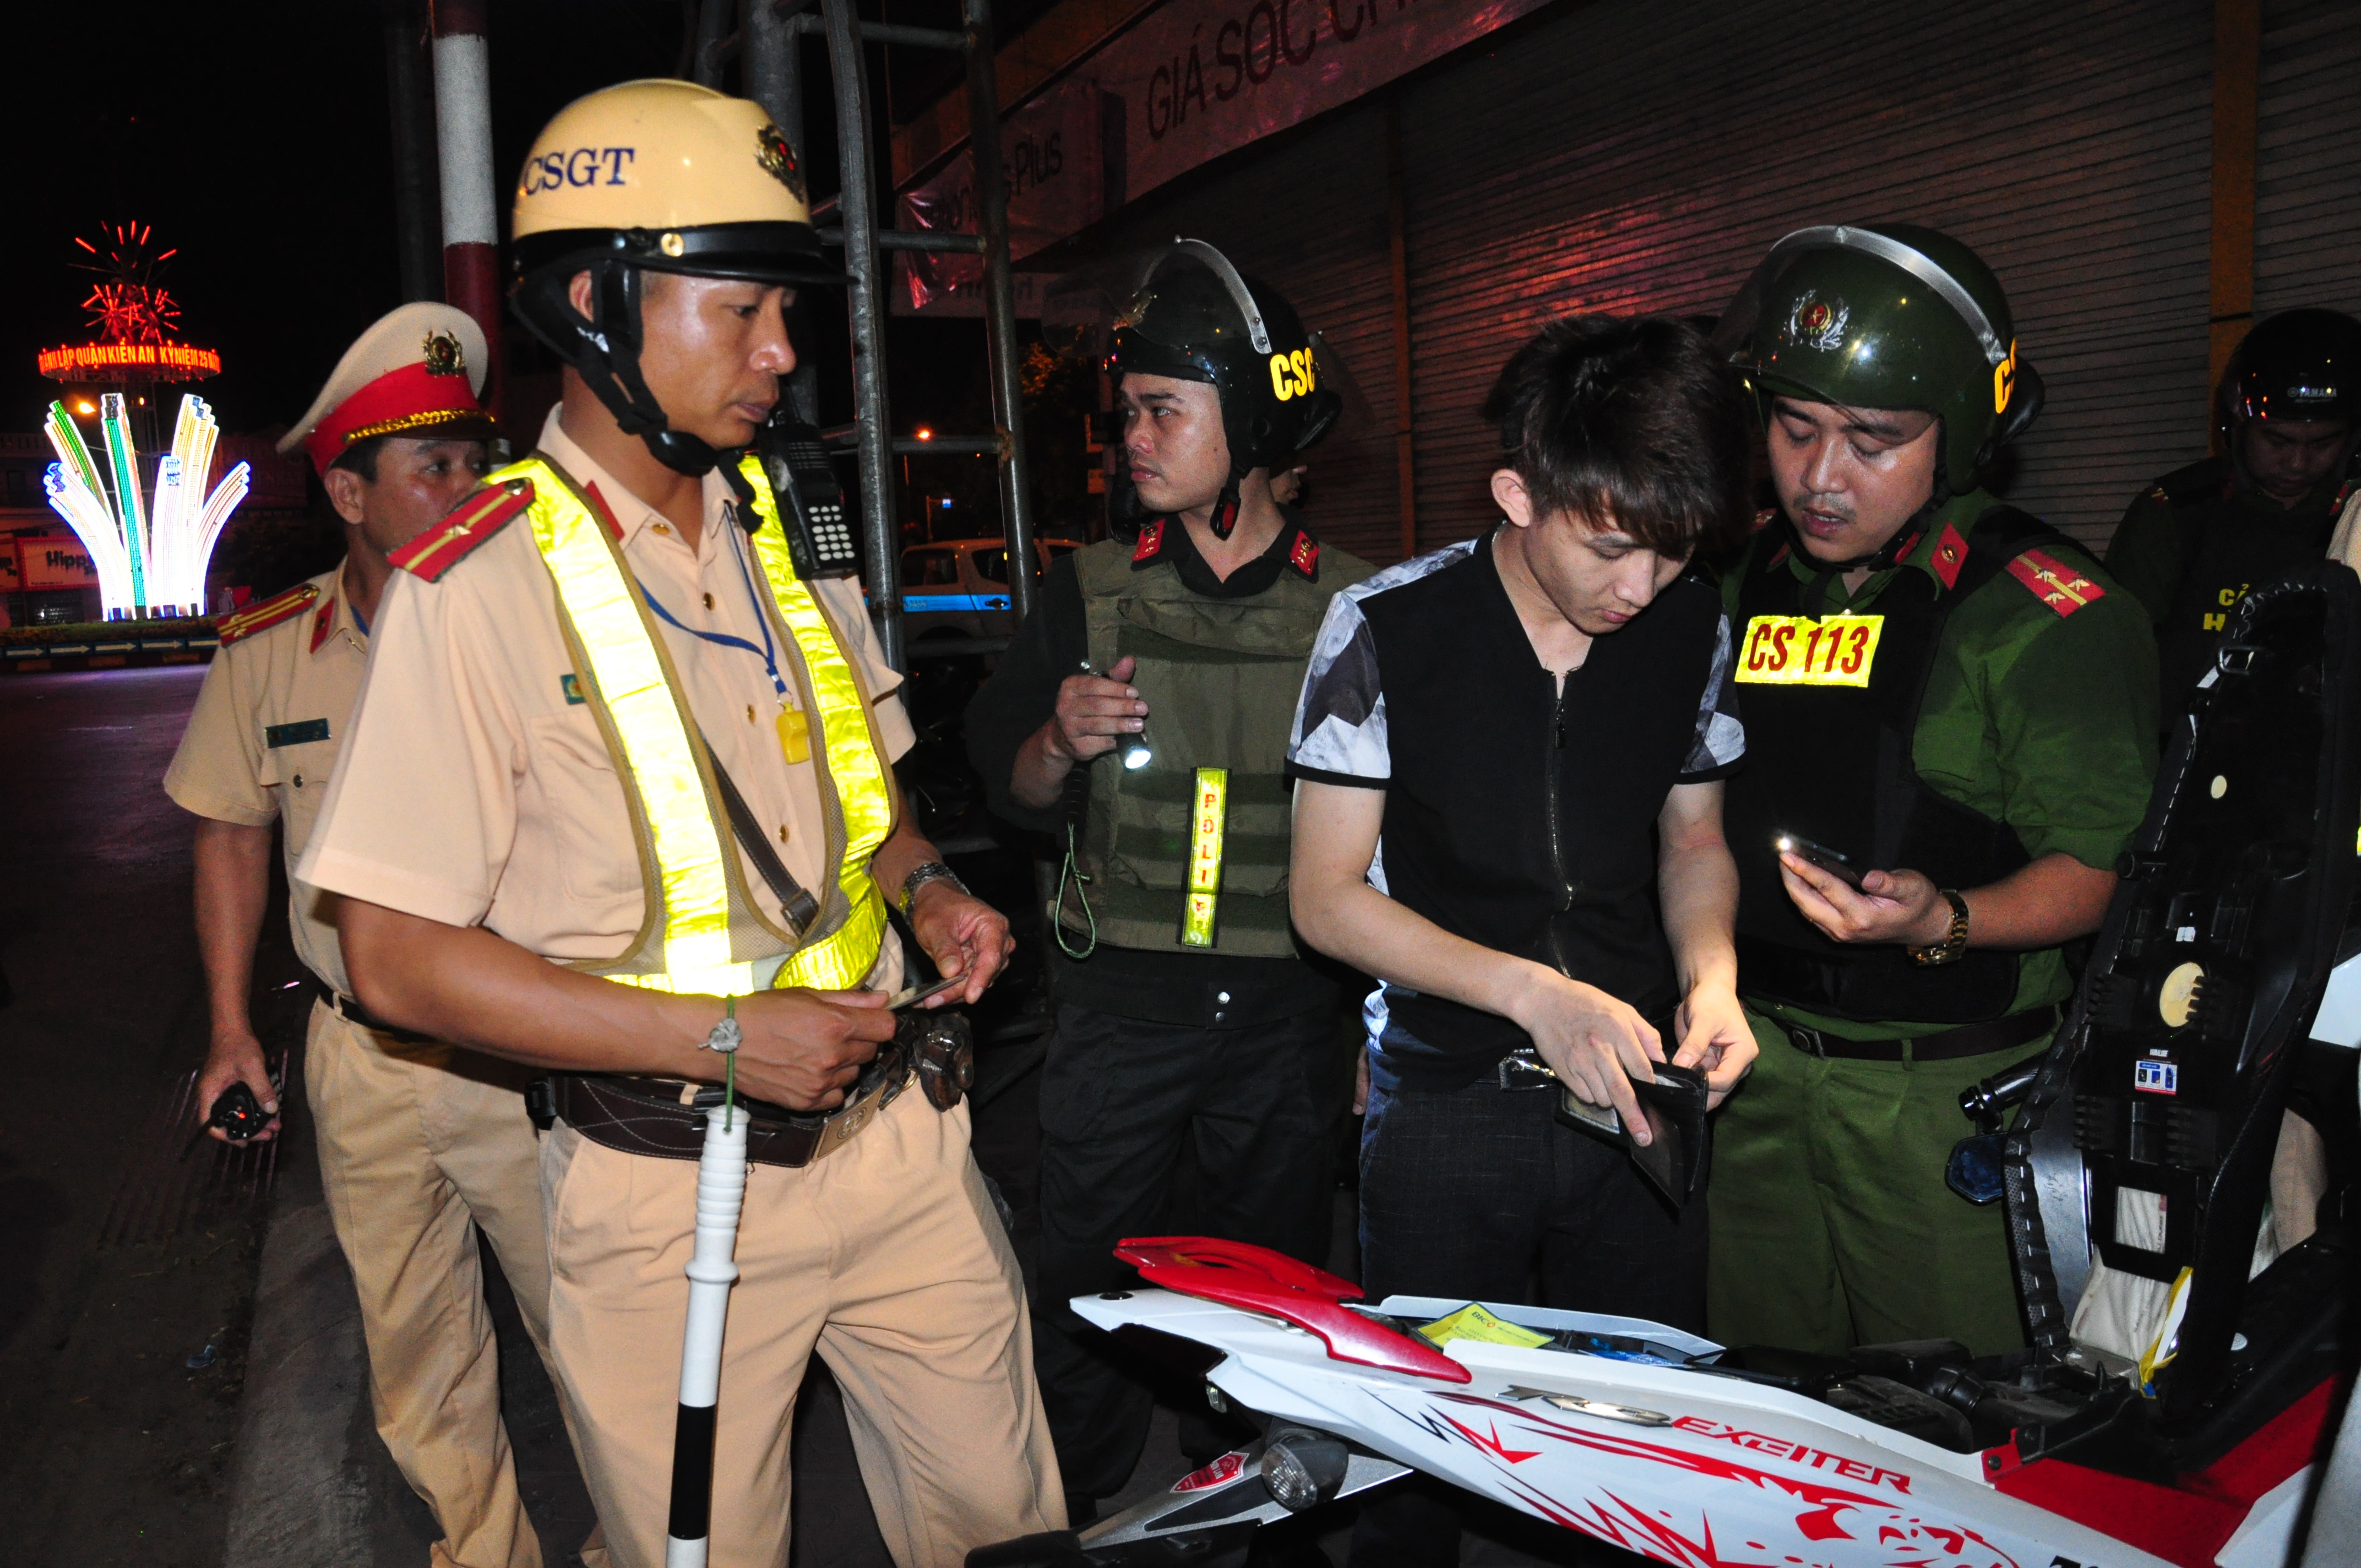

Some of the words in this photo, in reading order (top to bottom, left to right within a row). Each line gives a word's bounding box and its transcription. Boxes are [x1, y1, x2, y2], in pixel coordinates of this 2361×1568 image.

[1148, 23, 1206, 140] GIÁ
[523, 148, 635, 196] CSGT
[138, 345, 156, 363] AN
[1748, 623, 1796, 671] CS
[1804, 625, 1869, 674] 113
[1671, 1415, 1913, 1495] EXCITER
